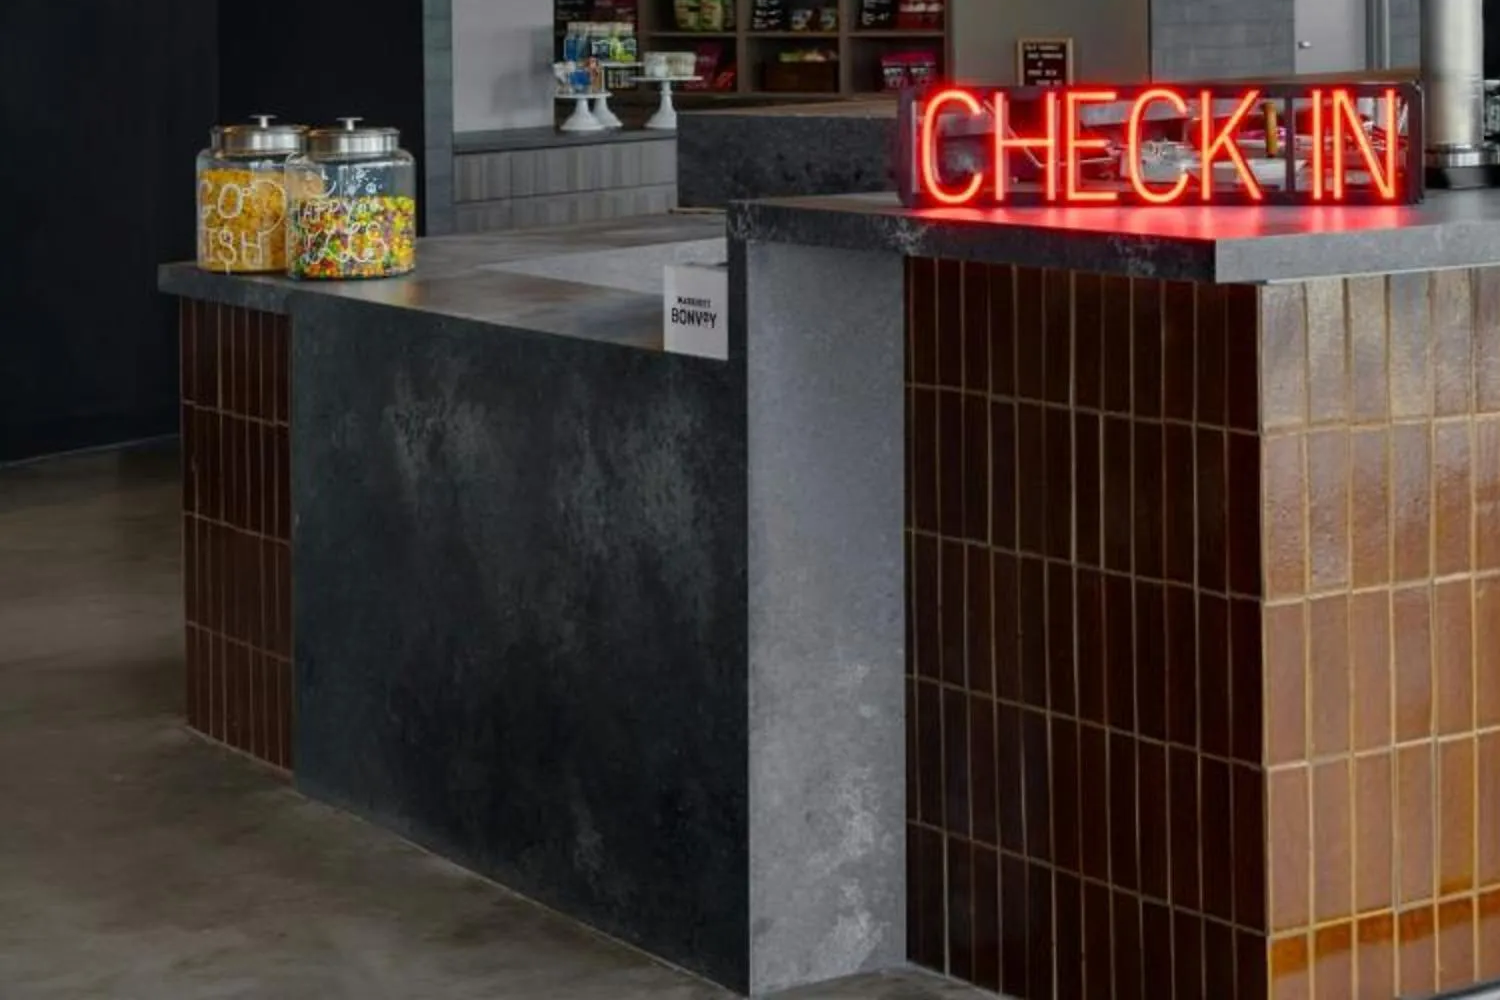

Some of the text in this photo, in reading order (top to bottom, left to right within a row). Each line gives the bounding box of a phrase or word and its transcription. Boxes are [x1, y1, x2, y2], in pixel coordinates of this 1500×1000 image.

[920, 87, 1398, 205] CHECK IN
[671, 307, 717, 328] BONVOY
